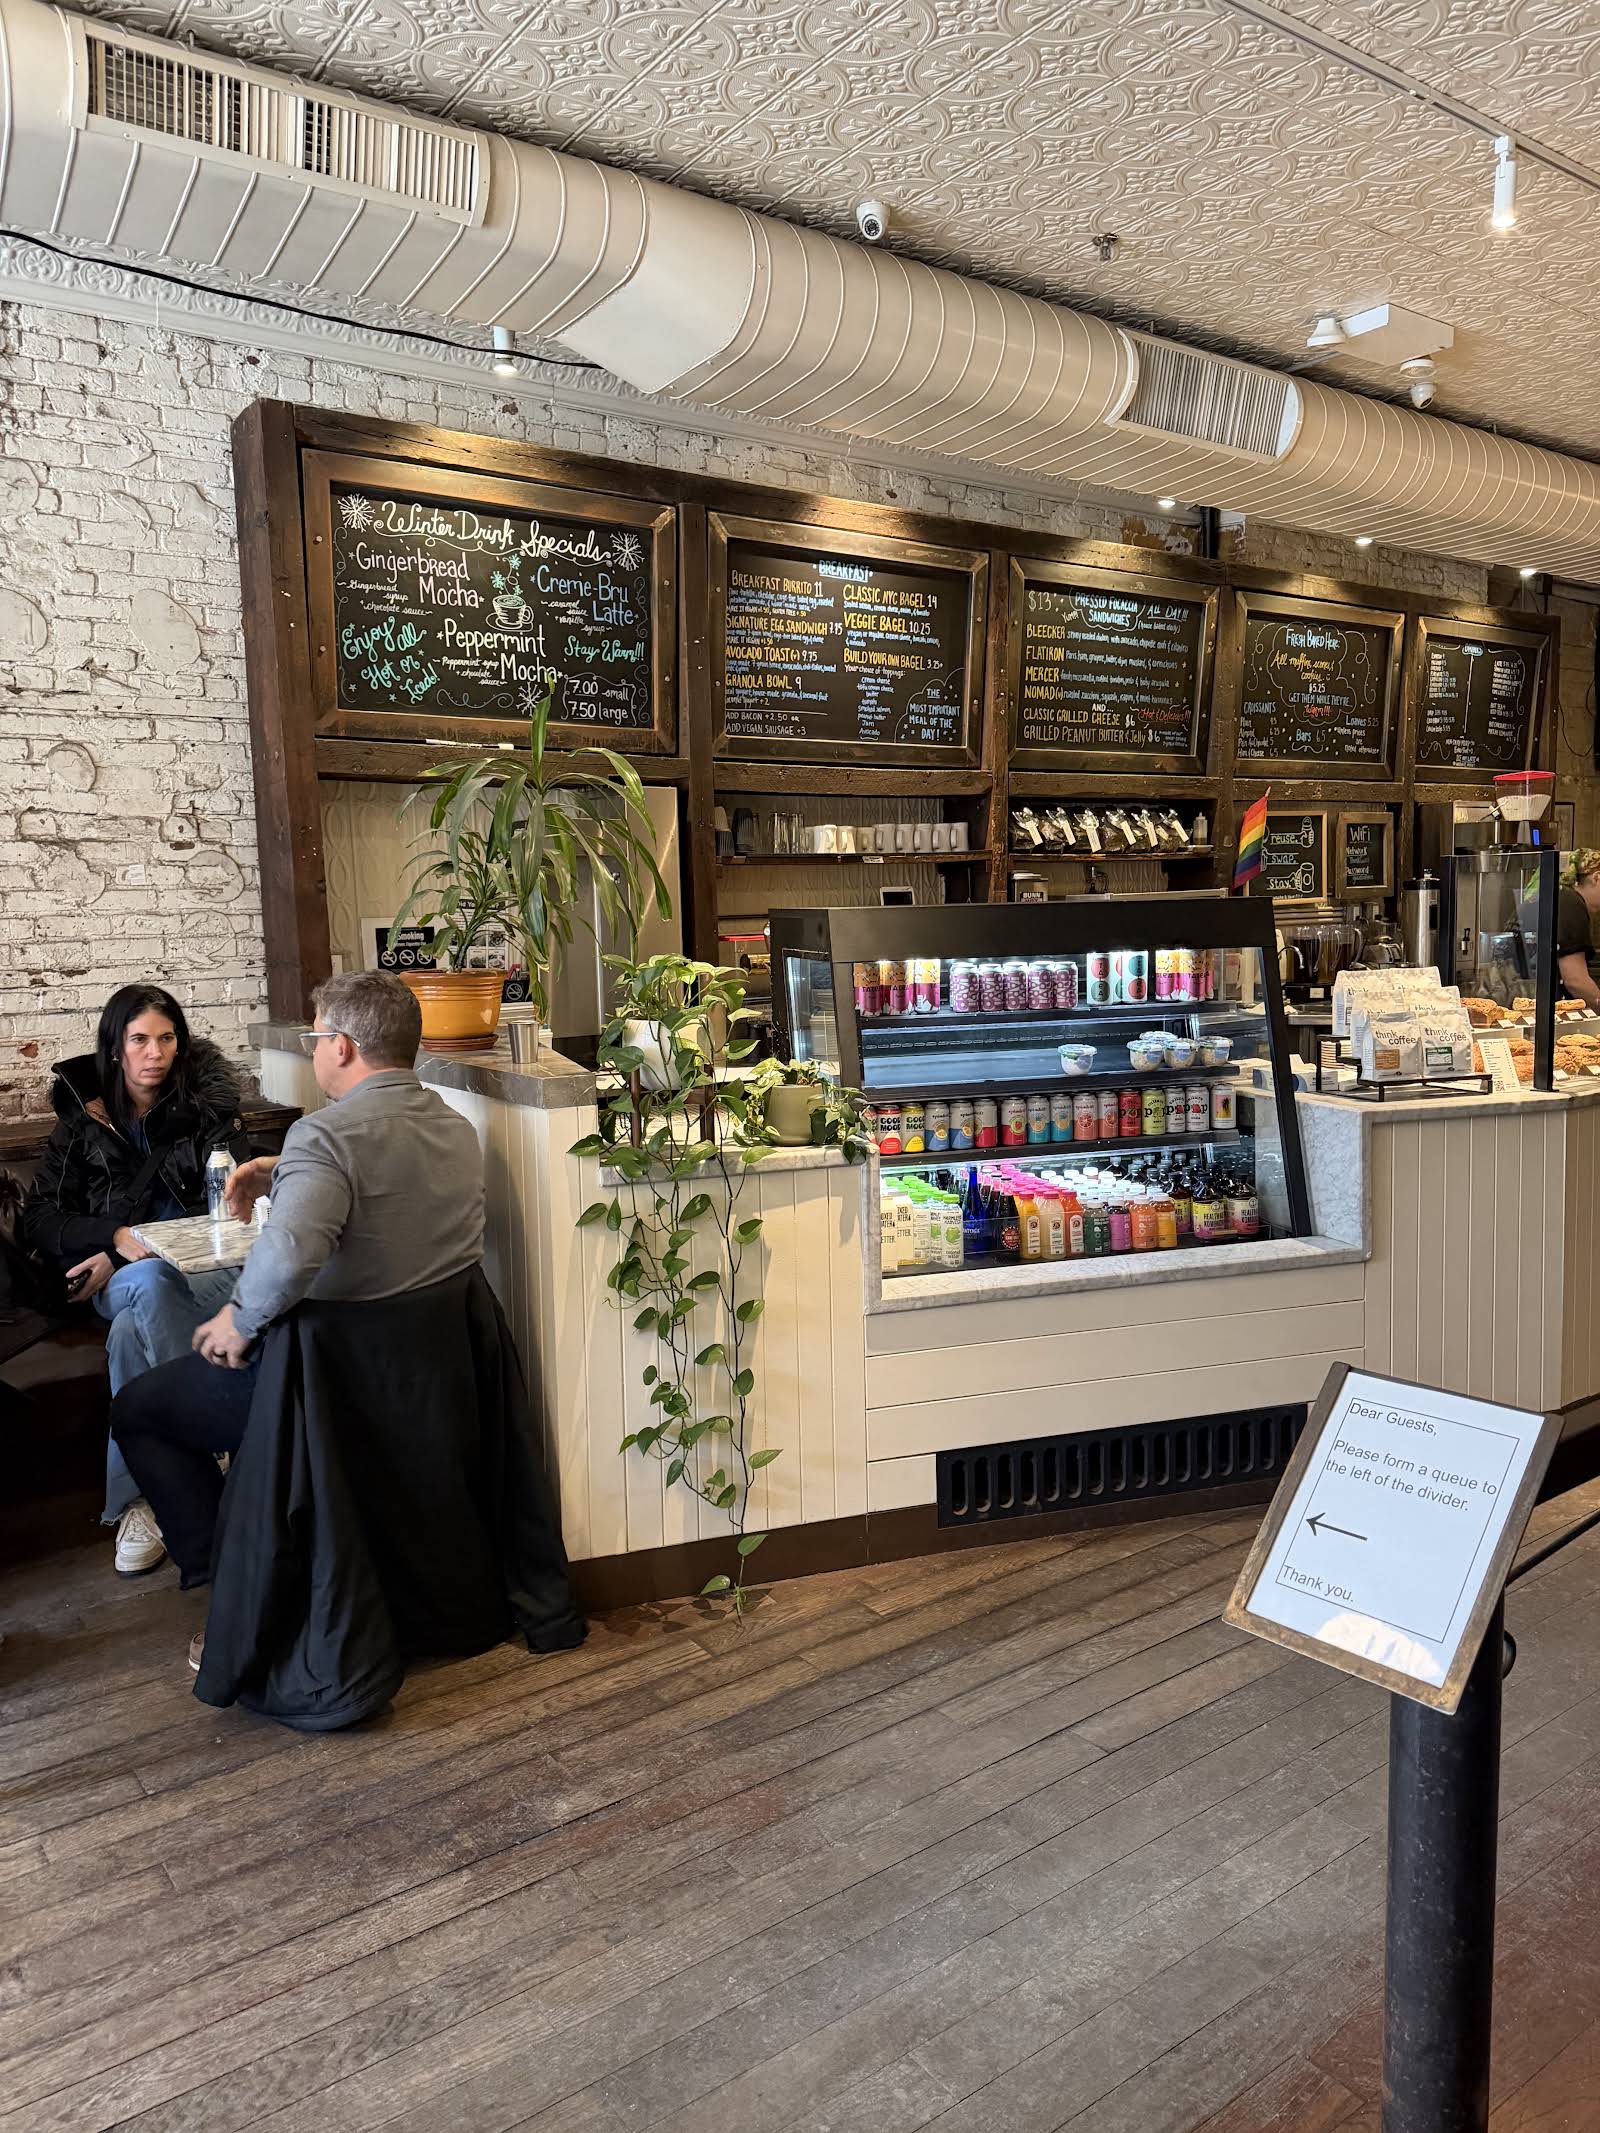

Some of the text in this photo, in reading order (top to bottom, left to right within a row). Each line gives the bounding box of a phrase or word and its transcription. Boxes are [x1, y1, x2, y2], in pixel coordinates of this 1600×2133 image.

[381, 501, 612, 561] Winter Drink Specials
[356, 542, 470, 583] Gingerbread
[819, 560, 870, 581] BREAKFAST
[347, 580, 398, 594] Gingerbread
[419, 576, 479, 608] Mocha
[537, 565, 629, 603] Creme-Bru
[732, 570, 824, 598] BREAKFAST BURRITO 11
[382, 592, 408, 604] syrup
[548, 600, 580, 609] caramel
[843, 584, 881, 604] CLASSIC
[882, 590, 898, 606] NYC
[899, 591, 926, 608] BAGEL
[927, 594, 938, 609] 14
[363, 602, 425, 616] chocolate sauce
[566, 609, 589, 617] sauce
[592, 600, 634, 627] Latte
[559, 615, 584, 625] vanilla
[726, 613, 769, 631] SIGNATURE
[770, 618, 785, 632] EGG
[786, 620, 828, 636] SANDWICH
[843, 611, 931, 635] VEGGIE BAGEL 10.25
[1088, 609, 1131, 628] SANDWICHES
[444, 618, 547, 658] Peppermint
[581, 624, 606, 636] syrup
[1026, 623, 1066, 640] BLEECKER
[1285, 629, 1306, 648] FRESH
[342, 616, 427, 662] Enjoy all
[565, 636, 644, 663] Stay Warm!!!
[725, 646, 763, 661] AVOCADO
[1026, 645, 1065, 662] FLATIRON
[441, 656, 500, 671] Peppermint syrup
[843, 647, 868, 664] BUILD
[869, 650, 887, 666] YOUR
[900, 655, 926, 671] BAGEL
[1270, 650, 1288, 670] All
[361, 655, 420, 690] Hot or
[501, 653, 558, 684] Mocha
[1025, 666, 1060, 683] MERCER
[399, 663, 441, 704] Iced!
[478, 678, 501, 687] sauce
[726, 673, 802, 690] GRANOLA BOWL 9
[1309, 683, 1326, 694] $5.25
[569, 681, 629, 701] 7.00 small
[926, 687, 941, 699] THE
[1289, 692, 1301, 703] GET
[1301, 694, 1315, 704] THEM
[568, 701, 628, 725] 7.50 large
[909, 702, 961, 718] MOST IMPORTANT
[1243, 701, 1276, 715] CROISSANTS
[741, 712, 763, 722] BACON
[909, 713, 953, 729] MEAL OF THE
[1023, 707, 1136, 729] CLASSIC GRILLED CHEESE $6
[1345, 715, 1366, 727] Loaves
[726, 722, 741, 733] ADD
[742, 723, 763, 734] VEGAN
[764, 724, 794, 735] SAUSAGE
[920, 727, 940, 741] DAY!
[1023, 725, 1060, 741] GRILLED
[1062, 726, 1097, 743] PEANUT
[1098, 728, 1125, 743] BUTTER
[1130, 729, 1146, 748] Jelly
[1296, 728, 1311, 742] Bars
[1270, 833, 1299, 844] reuse.
[1350, 825, 1370, 841] WiFi
[1376, 1026, 1398, 1039] think
[1388, 1034, 1417, 1046] coffee
[1425, 1026, 1449, 1037] think
[1439, 1031, 1468, 1042] coffee
[1348, 1402, 1438, 1436] Dear Guests,
[1333, 1440, 1498, 1497] Please form a queue to
[1325, 1459, 1470, 1512] the left of the divider.
[1281, 1563, 1355, 1604] Thank you.
